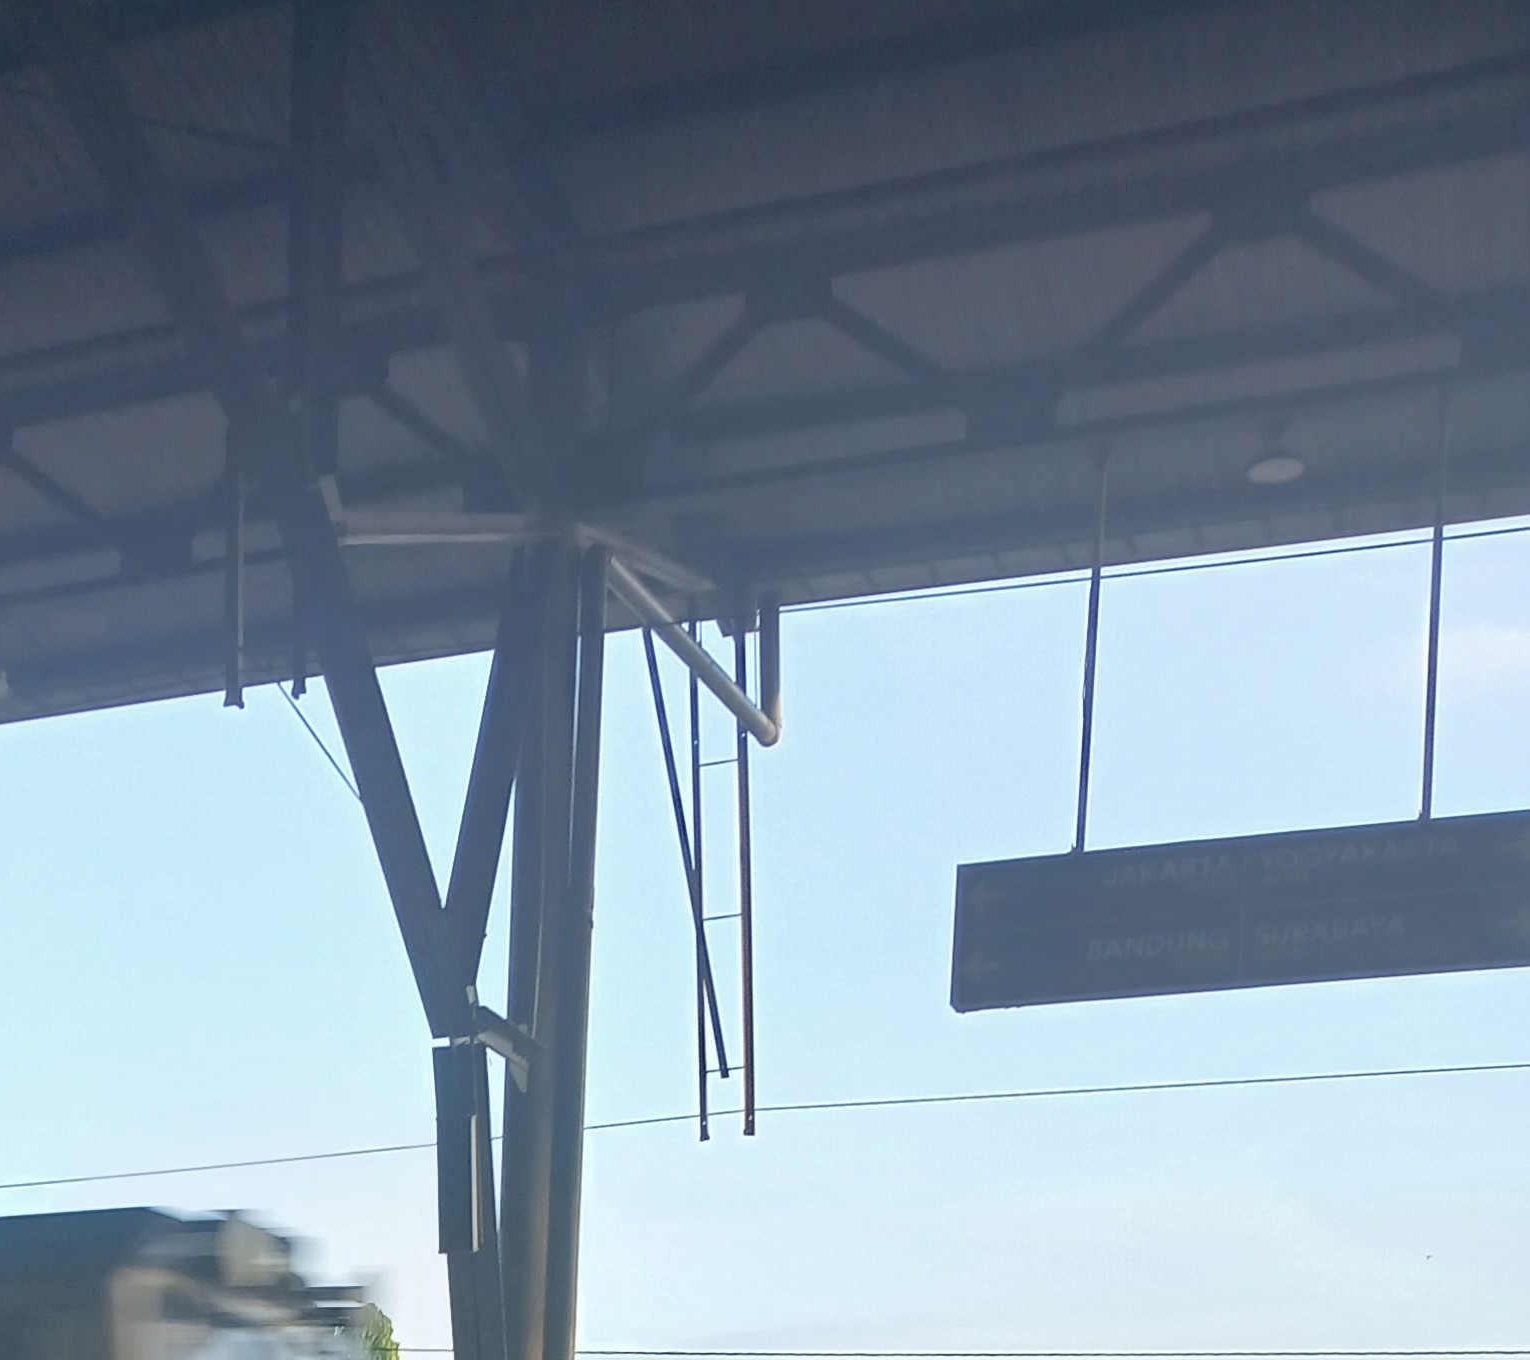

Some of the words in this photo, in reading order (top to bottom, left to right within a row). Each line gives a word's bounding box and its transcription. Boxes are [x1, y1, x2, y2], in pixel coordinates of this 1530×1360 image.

[1258, 833, 1460, 873] YOGYAKARTA
[1104, 854, 1235, 889] JAKARTA
[1087, 926, 1230, 962] BANDUNG
[1254, 912, 1407, 949] SURABAYA
